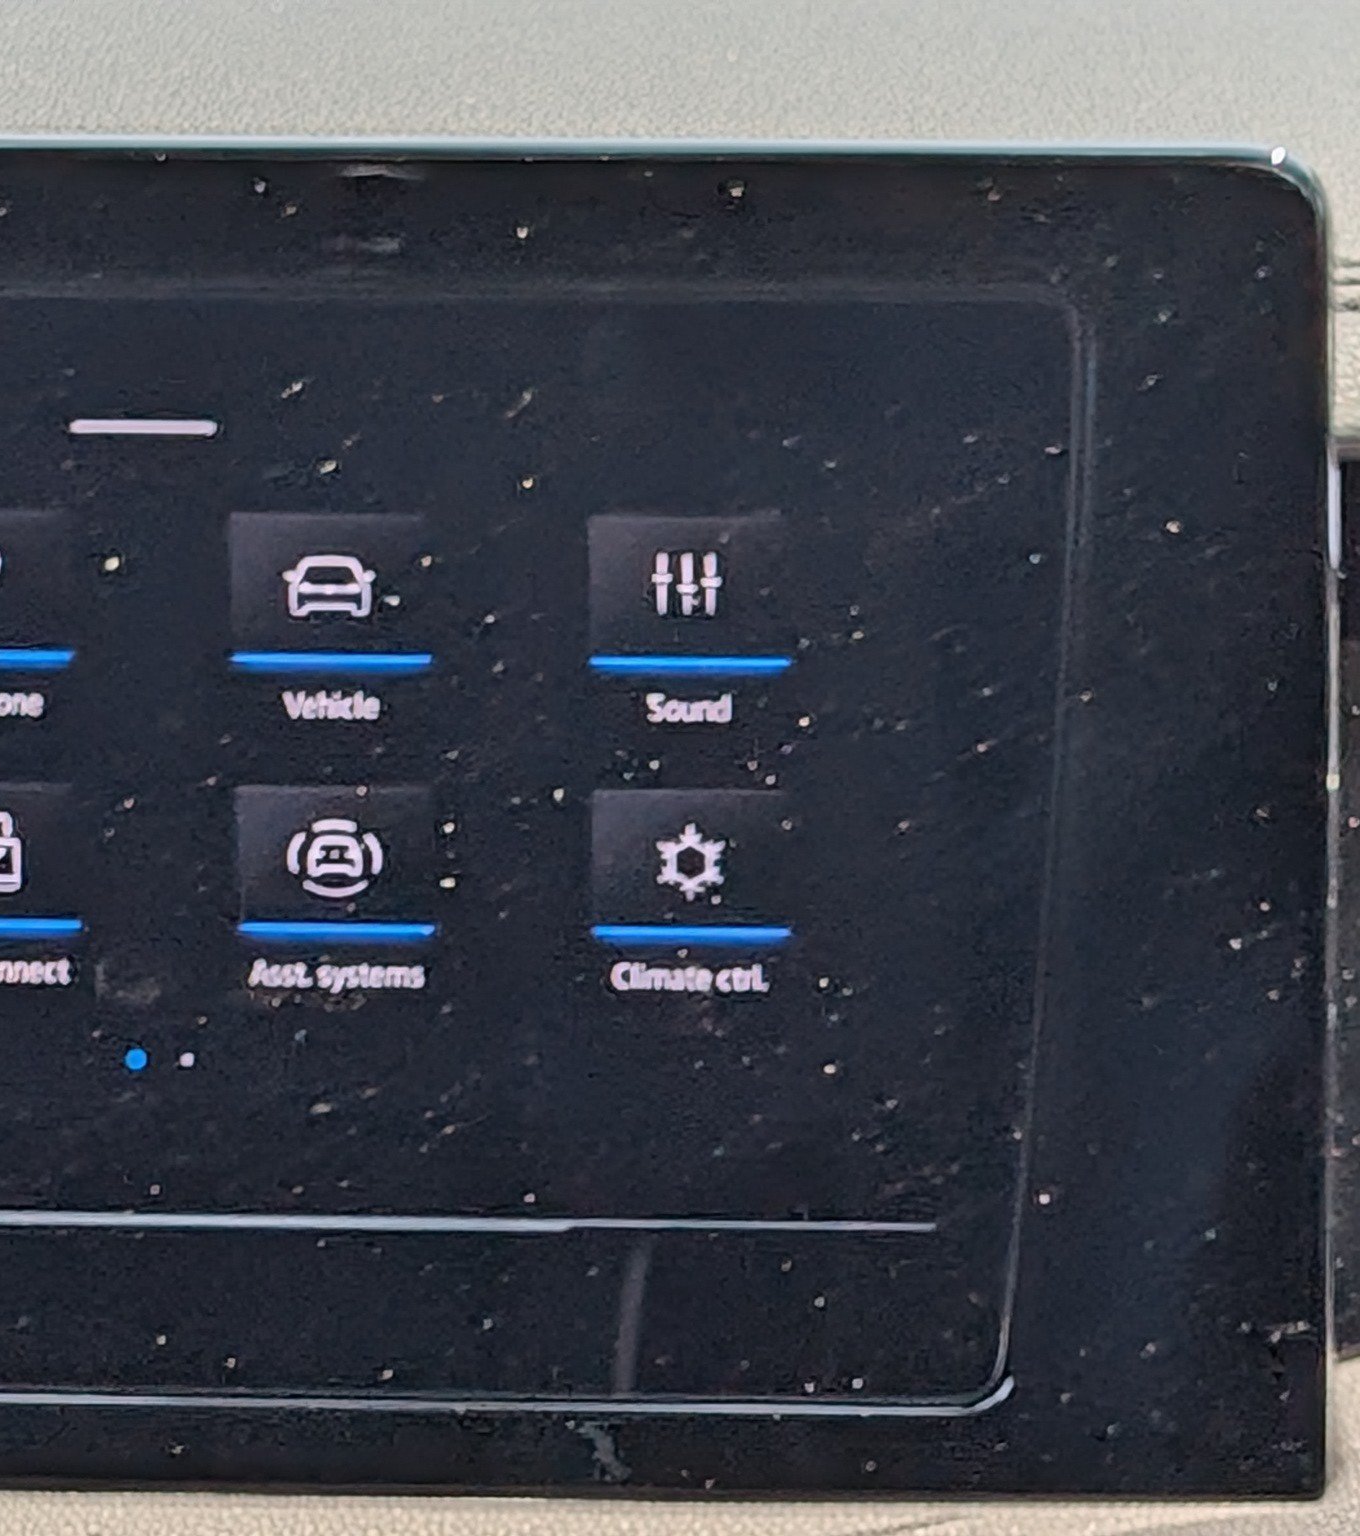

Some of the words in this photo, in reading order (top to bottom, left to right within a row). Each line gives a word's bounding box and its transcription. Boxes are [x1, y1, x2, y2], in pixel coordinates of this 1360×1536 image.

[282, 691, 381, 721] Vehicle
[646, 693, 732, 723] Sound
[316, 963, 425, 994] systems
[611, 962, 713, 992] Climate
